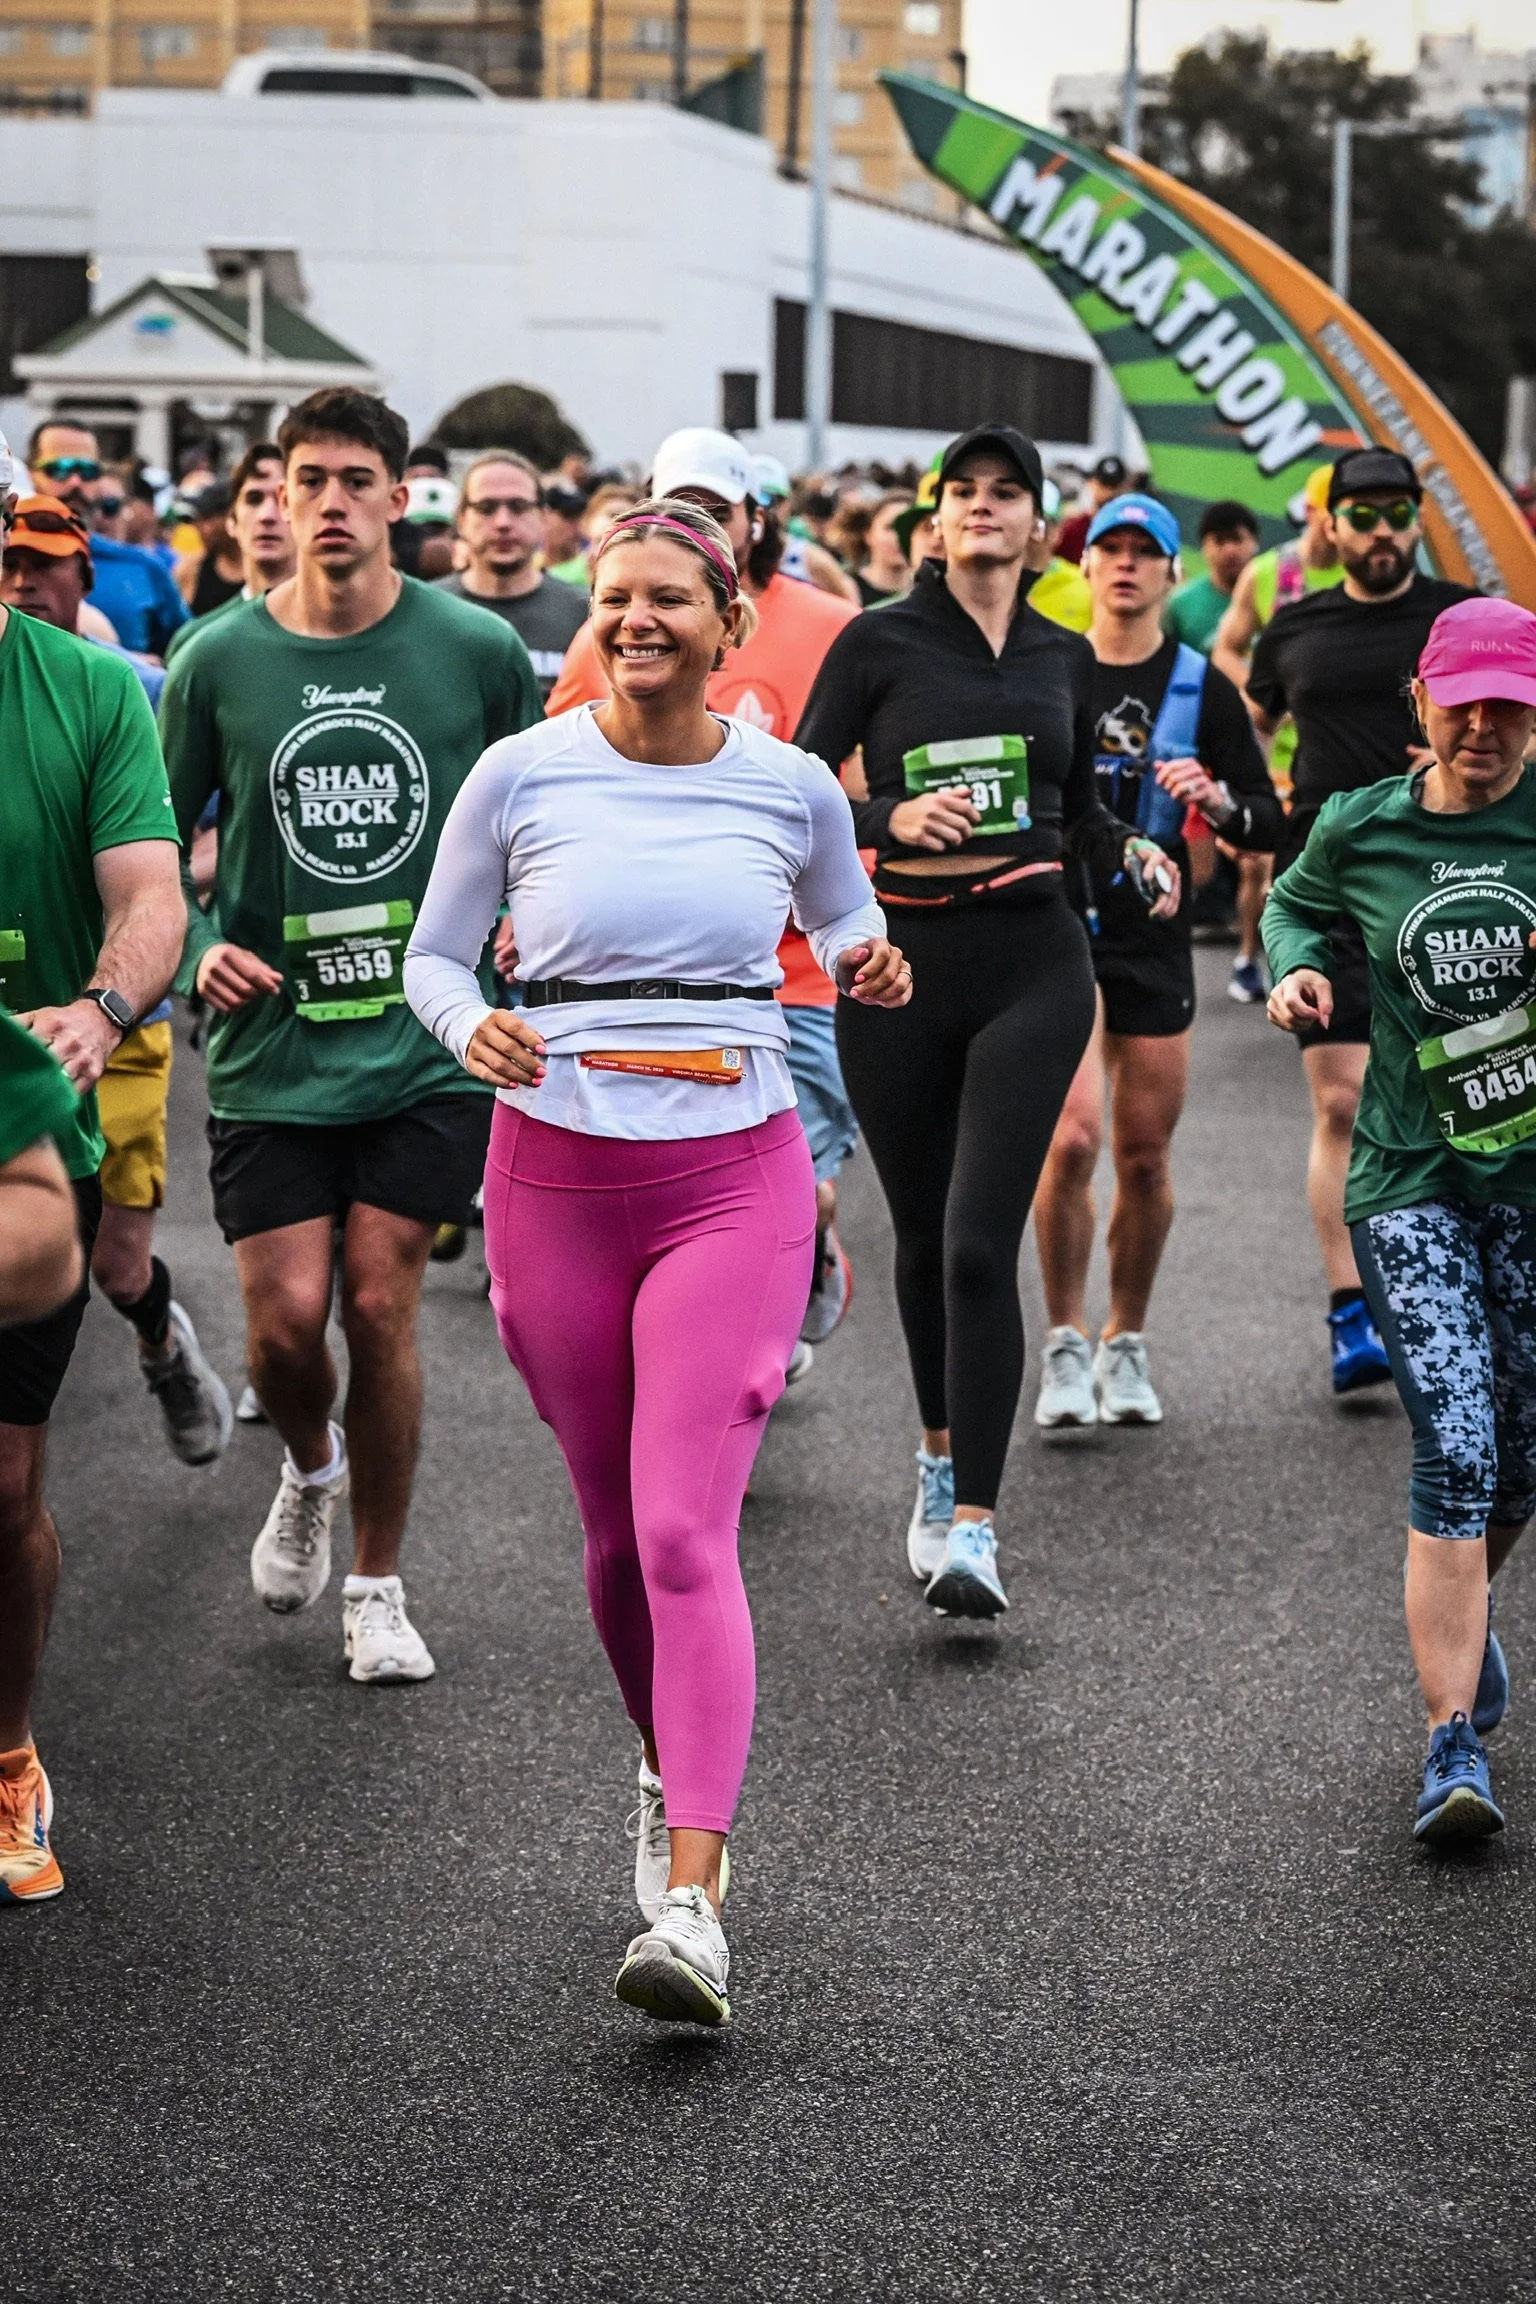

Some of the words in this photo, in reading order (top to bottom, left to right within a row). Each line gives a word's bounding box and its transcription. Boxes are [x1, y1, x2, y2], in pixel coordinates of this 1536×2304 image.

[991, 157, 1323, 472] MARATHON
[295, 763, 399, 791] SHAM
[300, 799, 398, 828] ROCK
[334, 831, 368, 849] 13.1
[1431, 860, 1507, 884] Yuengling
[1402, 913, 1428, 949] ANTHEM
[1425, 889, 1479, 915] SHAMROCK
[1479, 888, 1506, 900] HALF
[1424, 925, 1524, 954] SHAM
[316, 948, 394, 985] 5559
[1431, 957, 1524, 986] ROCK
[298, 983, 310, 1001] 3
[1412, 973, 1441, 1010] VIRGINIA
[1467, 984, 1498, 1002] 13.1
[1448, 1069, 1477, 1084] Anthem
[1463, 1055, 1536, 1111] 8454
